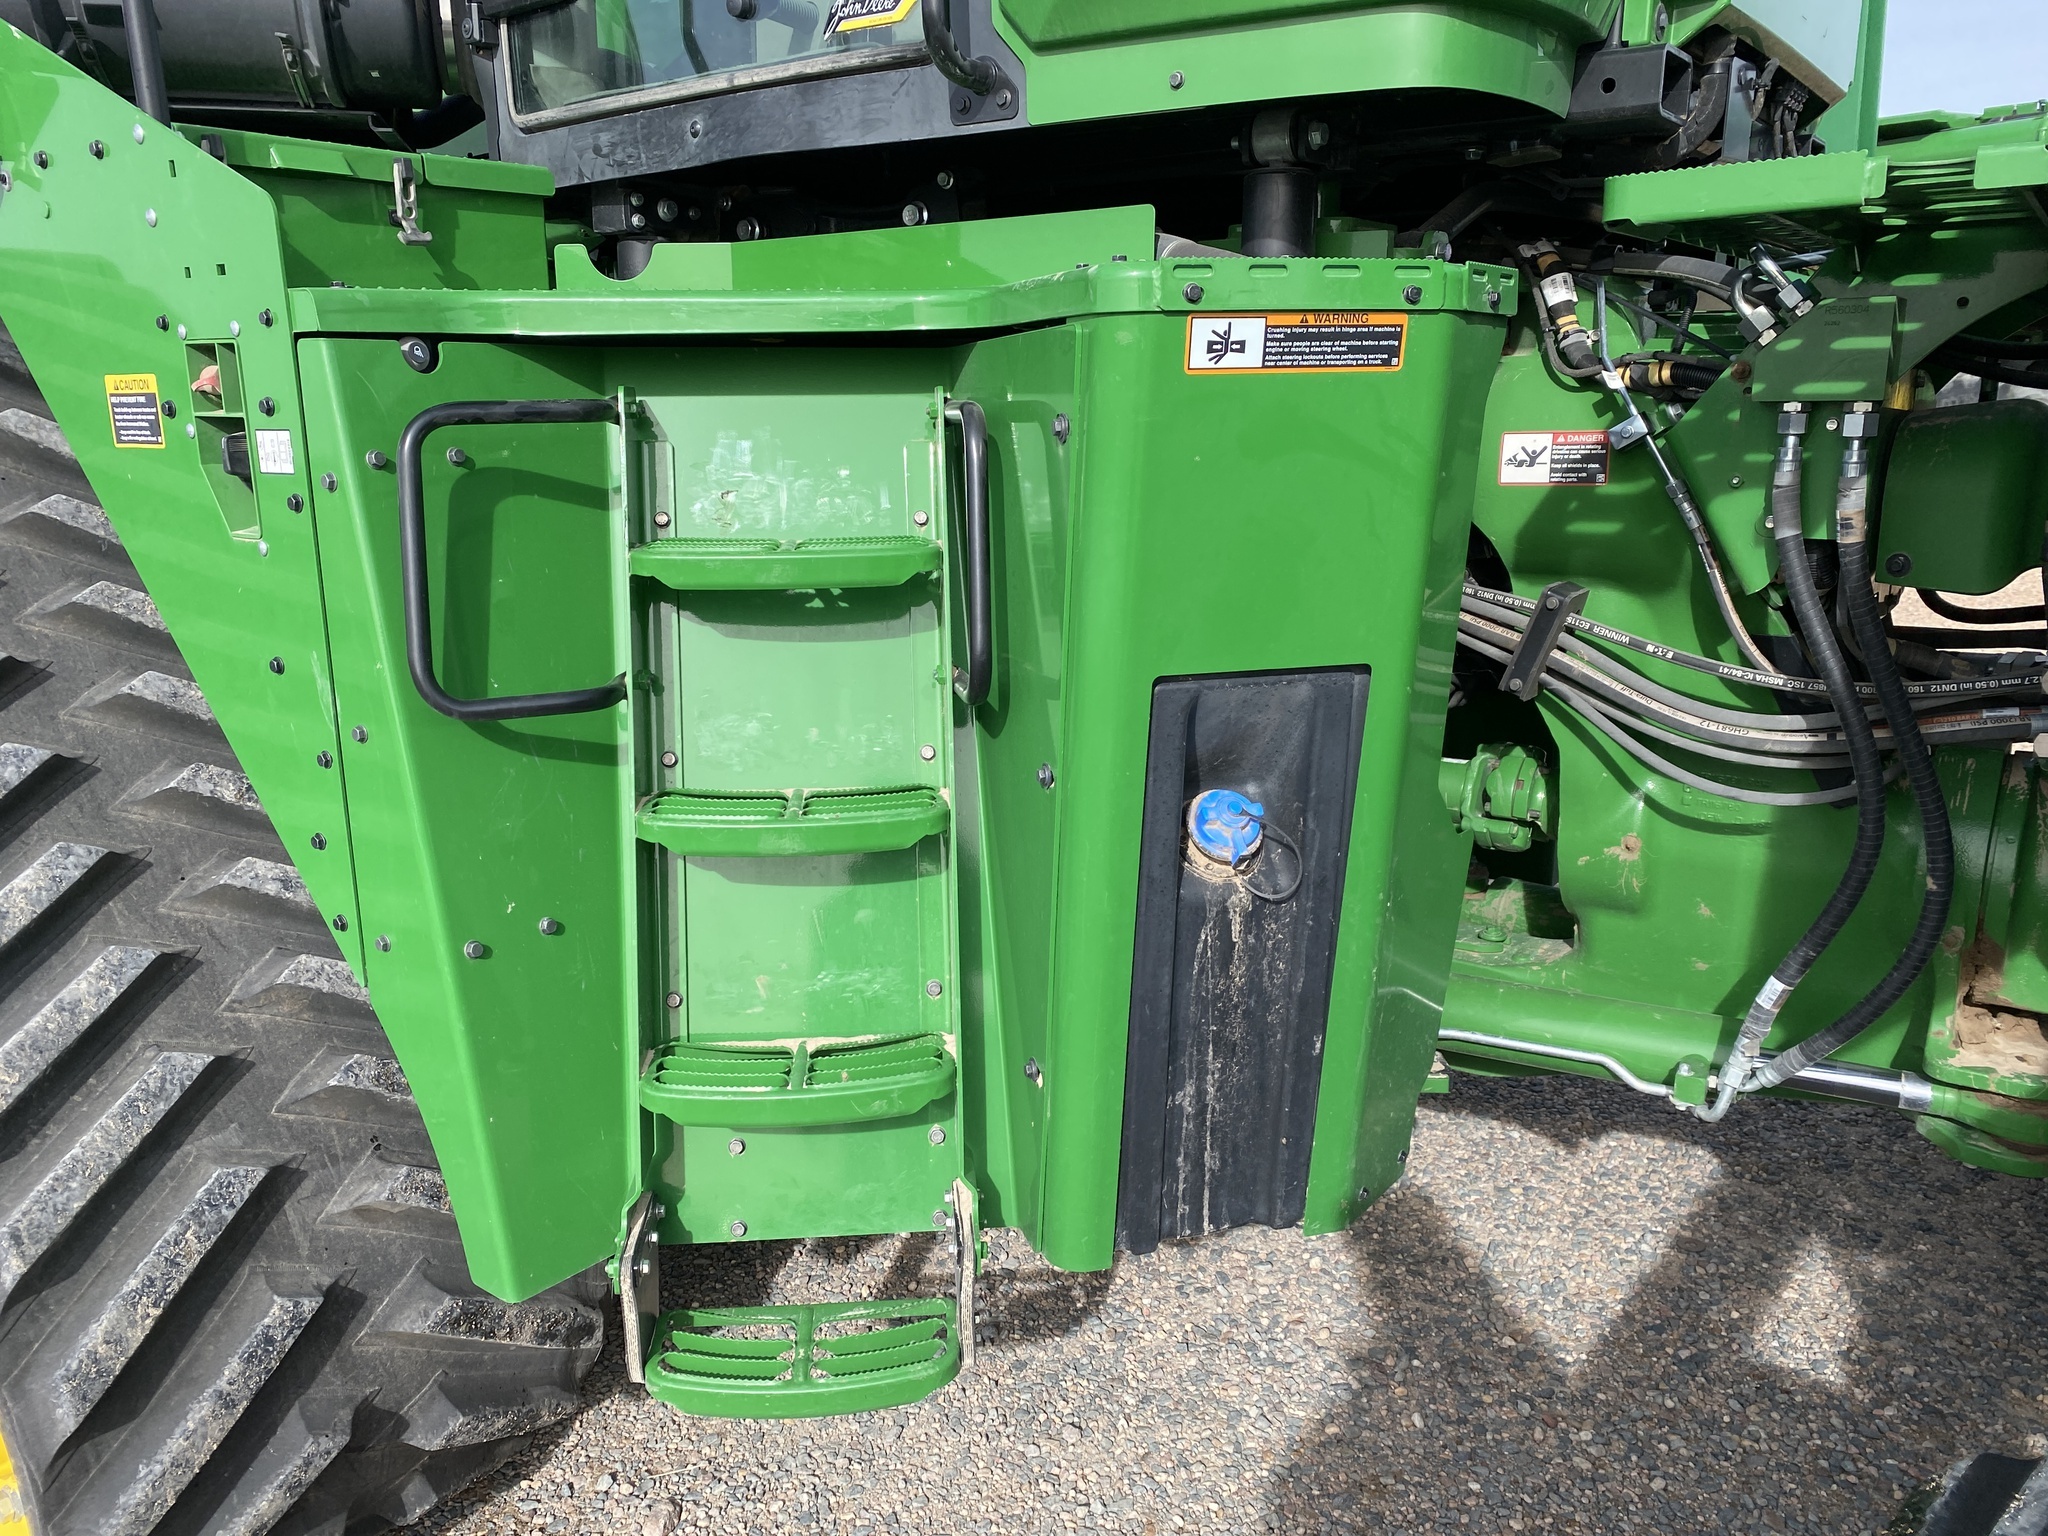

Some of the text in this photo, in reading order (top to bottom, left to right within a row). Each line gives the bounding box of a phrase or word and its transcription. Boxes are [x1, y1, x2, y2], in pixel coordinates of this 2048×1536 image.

[824, 0, 862, 40] John
[1313, 313, 1369, 324] WARNING
[119, 379, 150, 390] CAUTION
[1567, 434, 1604, 442] DANGER
[1476, 590, 1494, 600] DN12
[1504, 597, 1522, 607] (0.50
[1592, 625, 1630, 644] WINNER
[1718, 665, 1753, 680] IC-84/41
[1755, 674, 1784, 686] MSHA
[1787, 680, 1805, 689] 1SC
[1975, 679, 1999, 689] (0.50
[2001, 677, 2021, 686] mm
[1908, 685, 1925, 693] 160
[1930, 683, 1957, 692] DN12
[1960, 682, 1973, 691] in)
[1699, 719, 1750, 736] GH681-12
